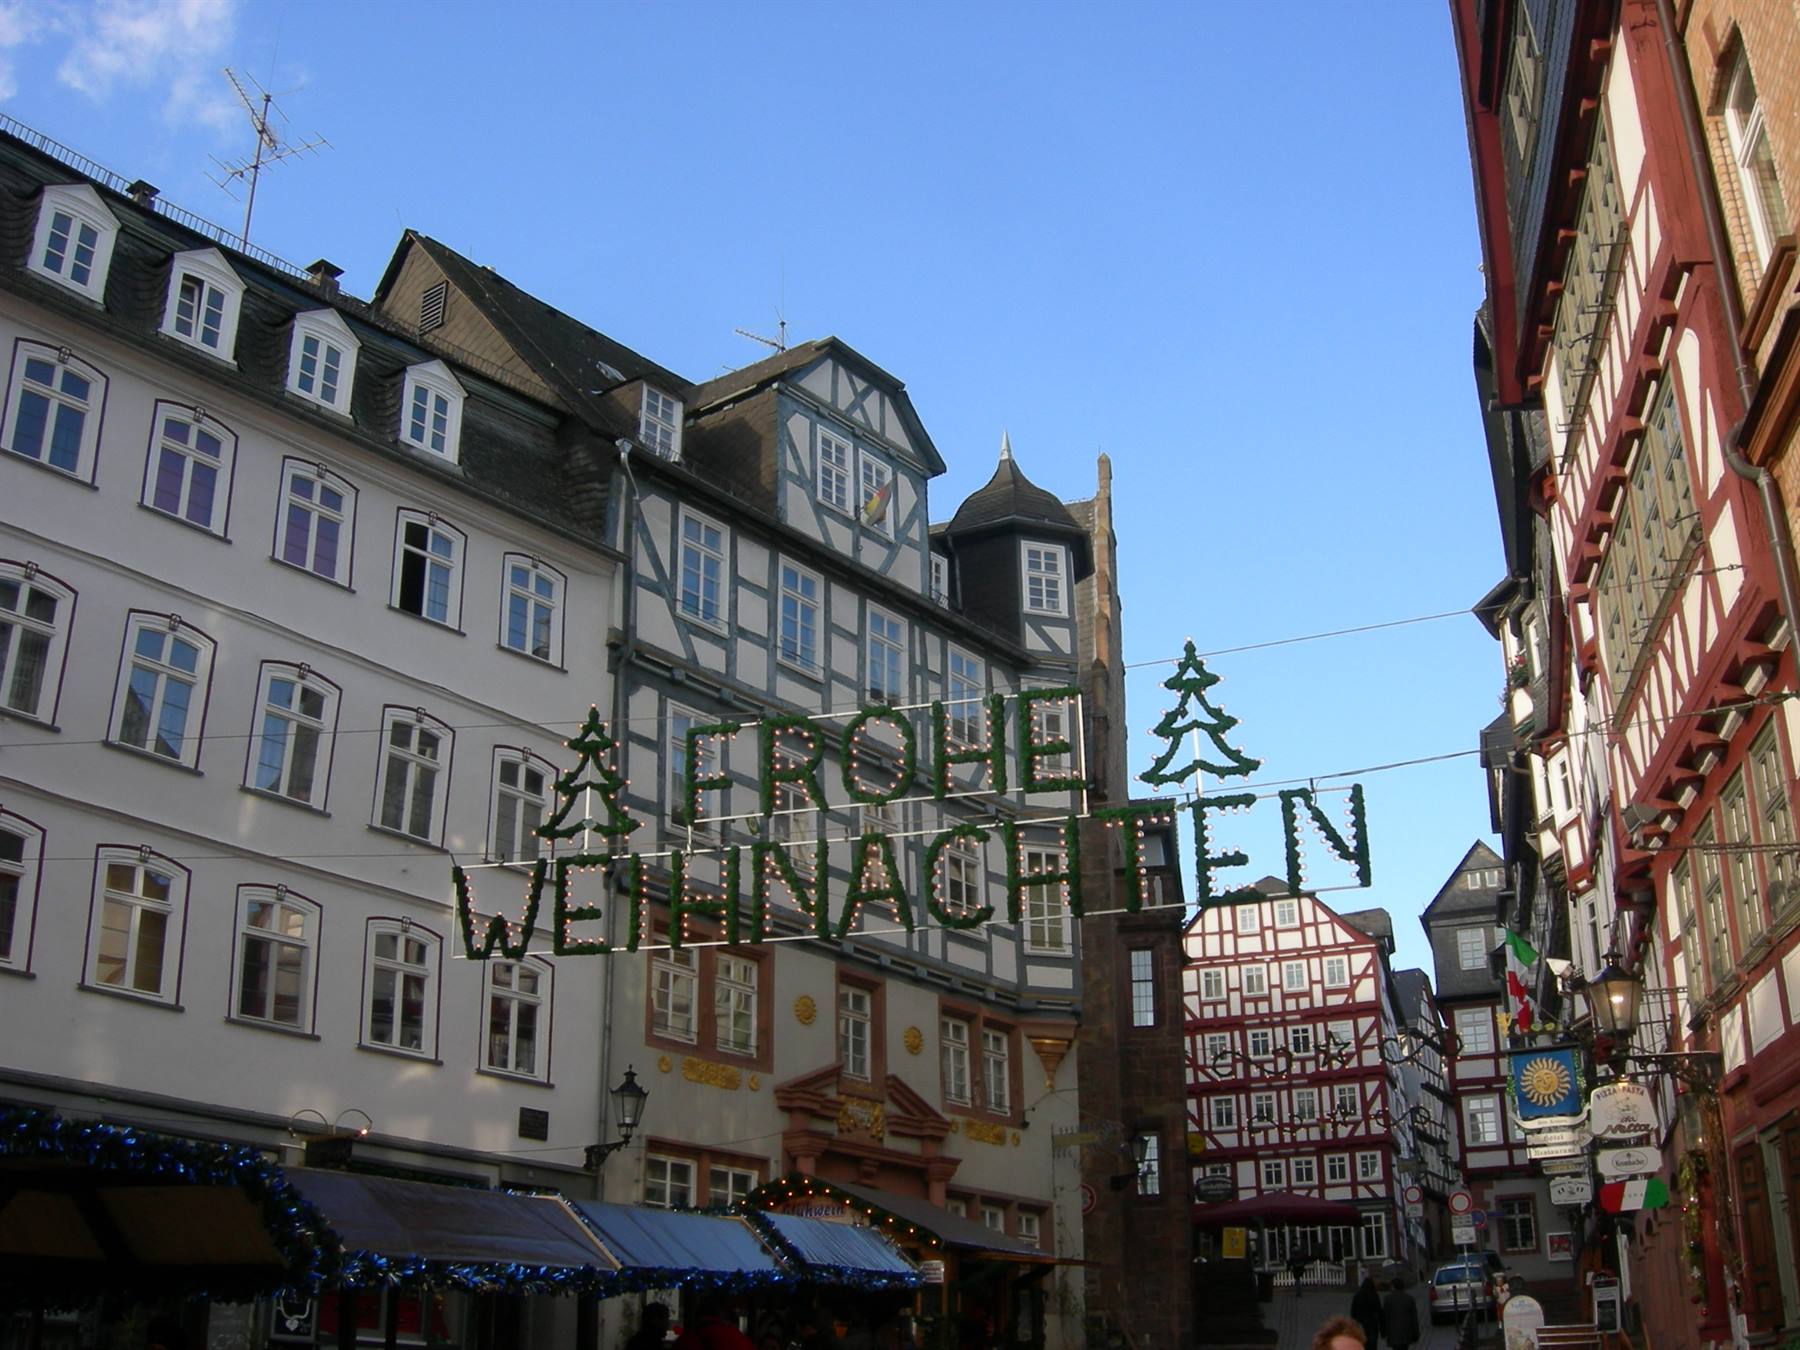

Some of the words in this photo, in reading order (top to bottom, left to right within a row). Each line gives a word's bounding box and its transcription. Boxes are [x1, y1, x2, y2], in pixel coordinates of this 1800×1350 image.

[685, 686, 1086, 822] FROHE
[452, 783, 1371, 960] WEIHNACHTEN
[1596, 1087, 1617, 1100] PIZZA
[1622, 1087, 1644, 1097] PASTA
